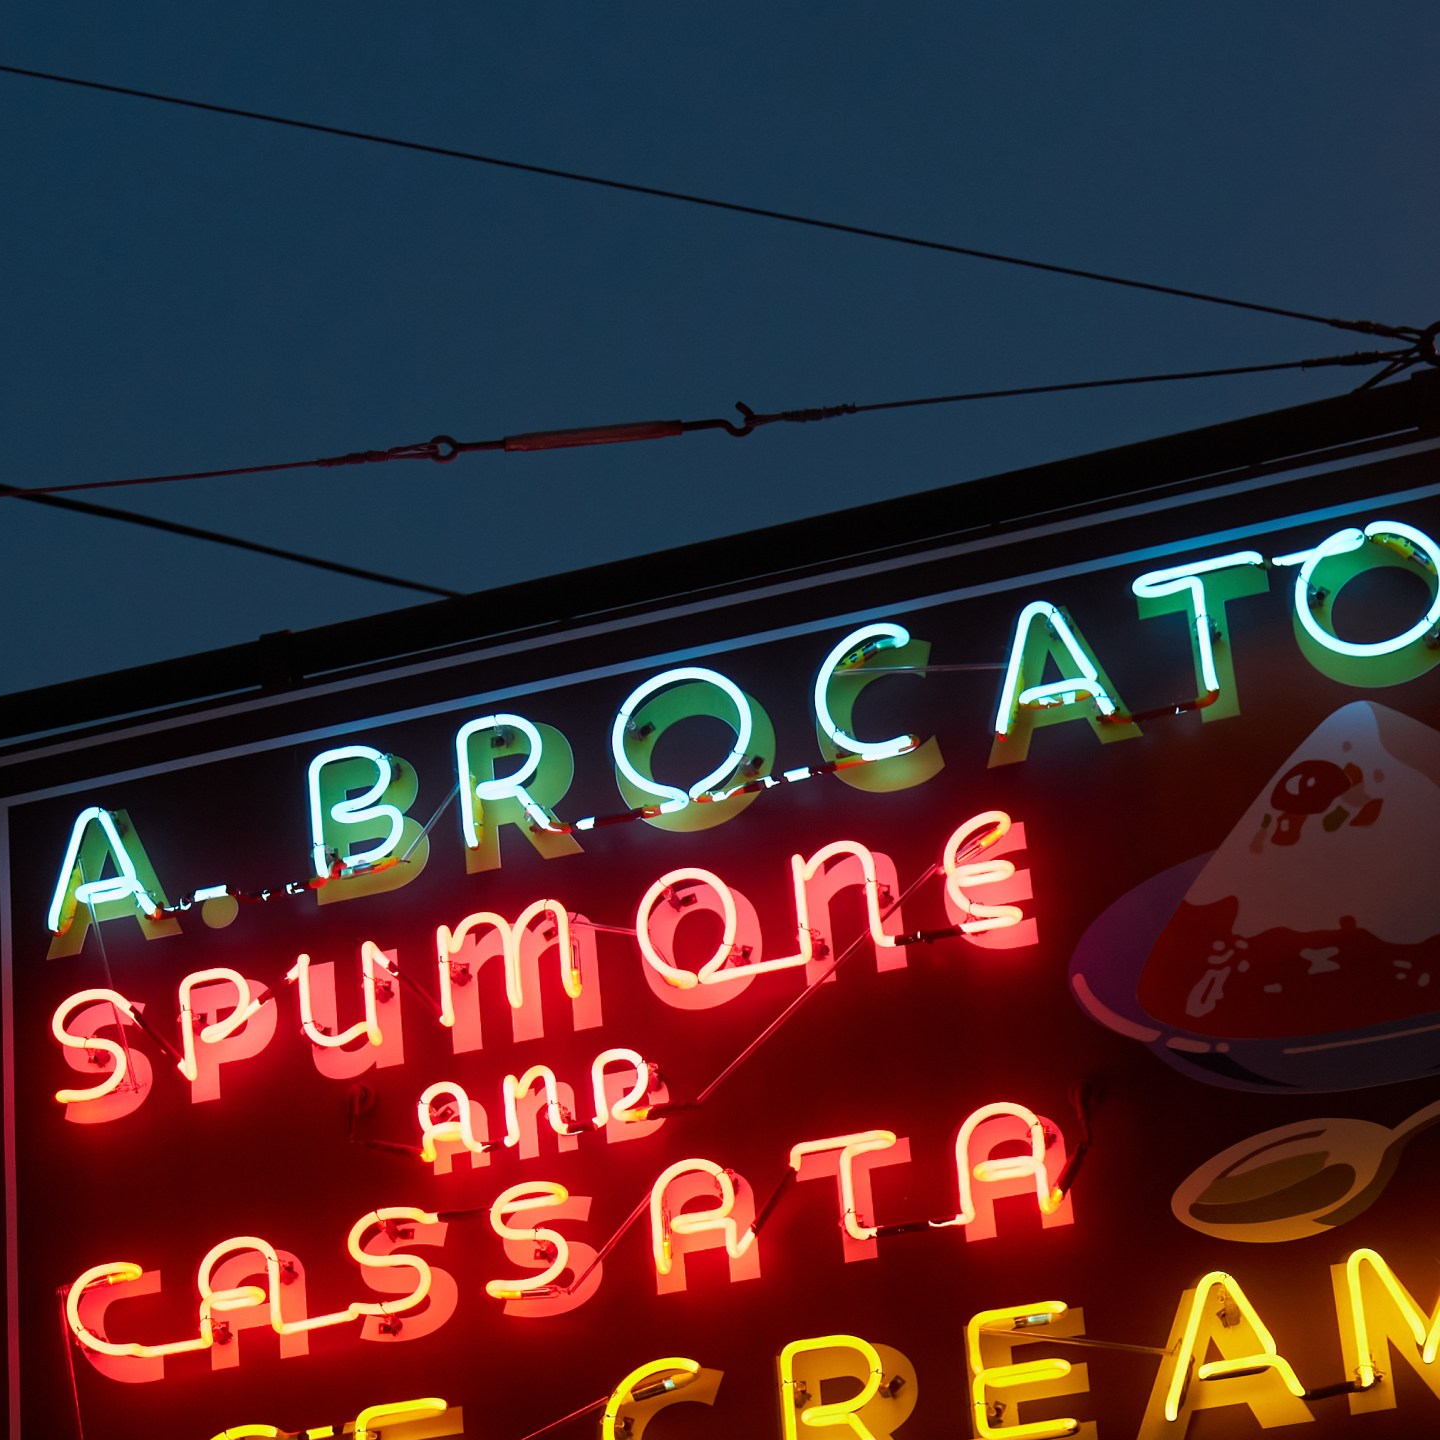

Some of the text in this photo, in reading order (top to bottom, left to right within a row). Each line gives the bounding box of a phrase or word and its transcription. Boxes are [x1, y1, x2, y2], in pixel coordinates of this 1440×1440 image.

[45, 519, 1440, 961] A. BROCATO
[51, 810, 1039, 1124] SPUMONE
[416, 1047, 670, 1176] AND
[66, 1101, 1075, 1384] CASSATA
